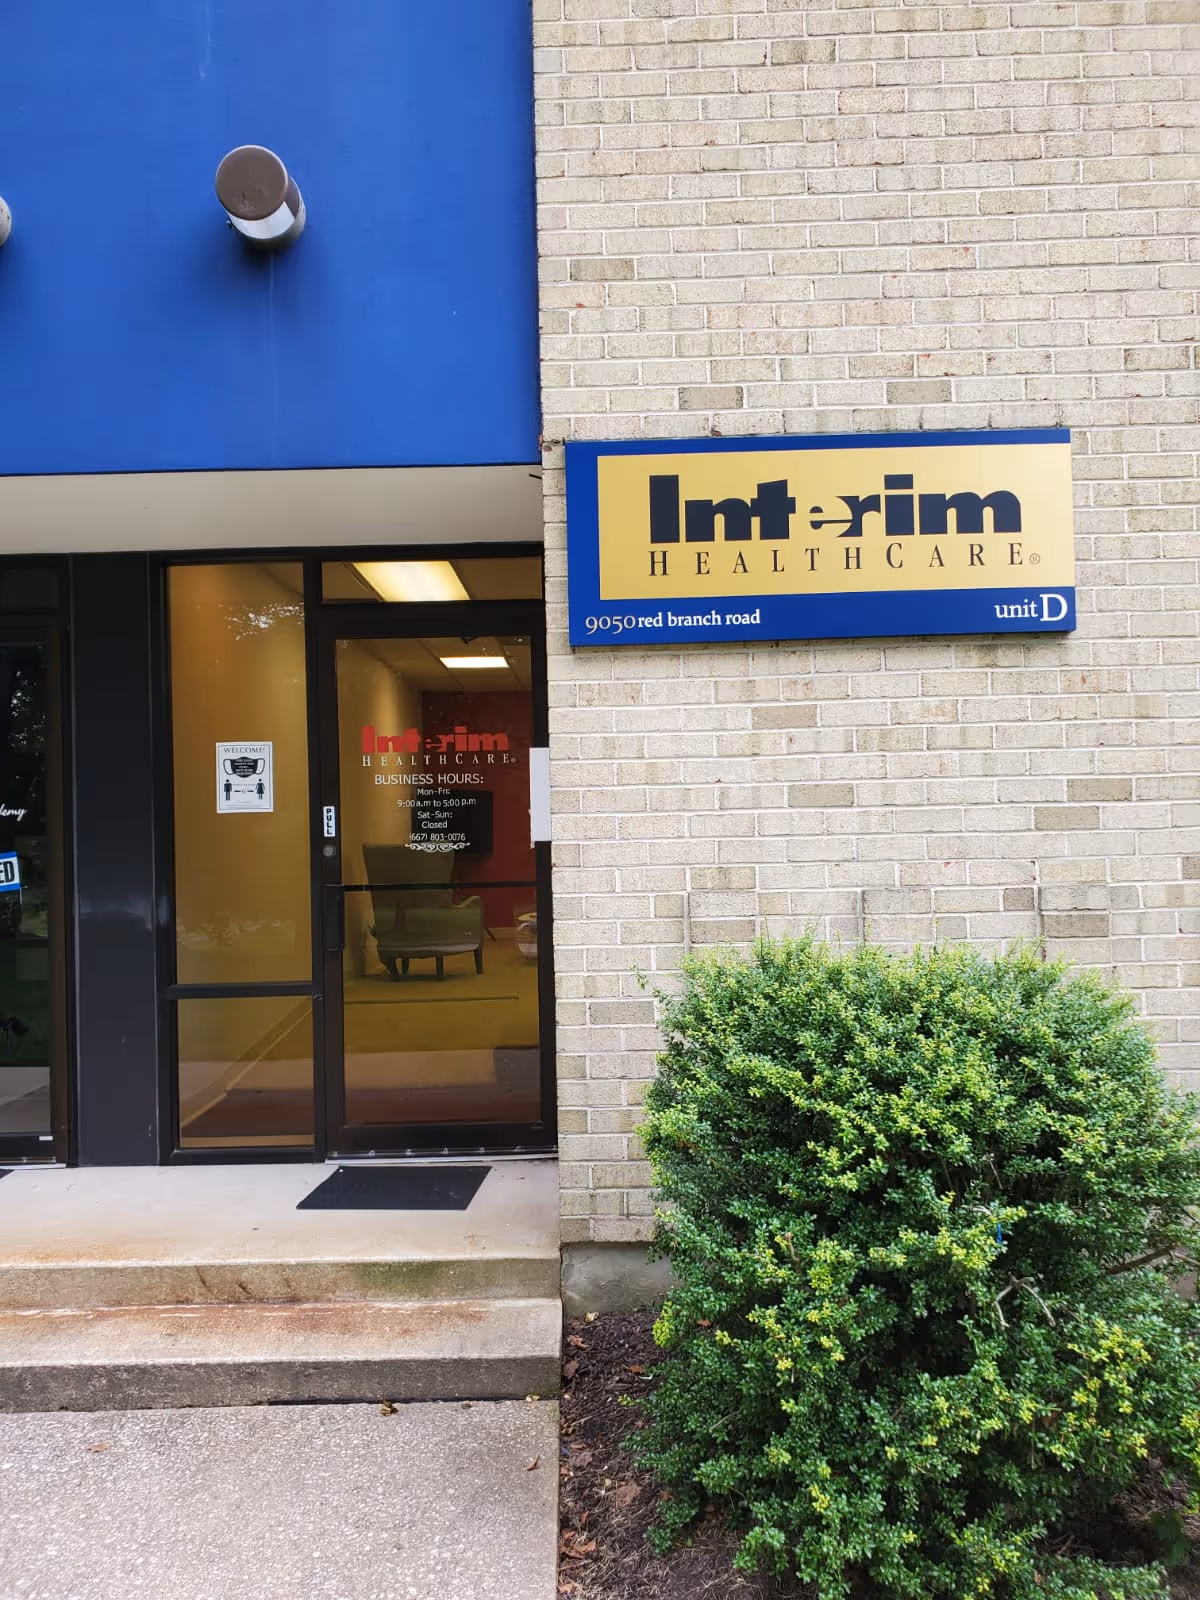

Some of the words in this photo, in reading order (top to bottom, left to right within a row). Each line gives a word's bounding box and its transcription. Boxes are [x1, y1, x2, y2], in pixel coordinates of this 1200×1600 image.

[648, 473, 1022, 544] Interim
[993, 598, 1039, 618] unit
[1039, 593, 1068, 622] D
[585, 615, 637, 635] 9050
[637, 611, 664, 628] red
[667, 609, 722, 628] branch
[725, 608, 761, 626] road
[361, 724, 510, 754] Interim
[374, 773, 434, 785] BUSINESS
[437, 772, 485, 785] HOURS:
[416, 786, 451, 796] Mon-Fri:
[433, 799, 442, 807] to
[416, 810, 453, 820] Sat-Sun:
[421, 820, 448, 830] Closed
[408, 832, 429, 842] (667)
[429, 832, 466, 842] 803-0076
